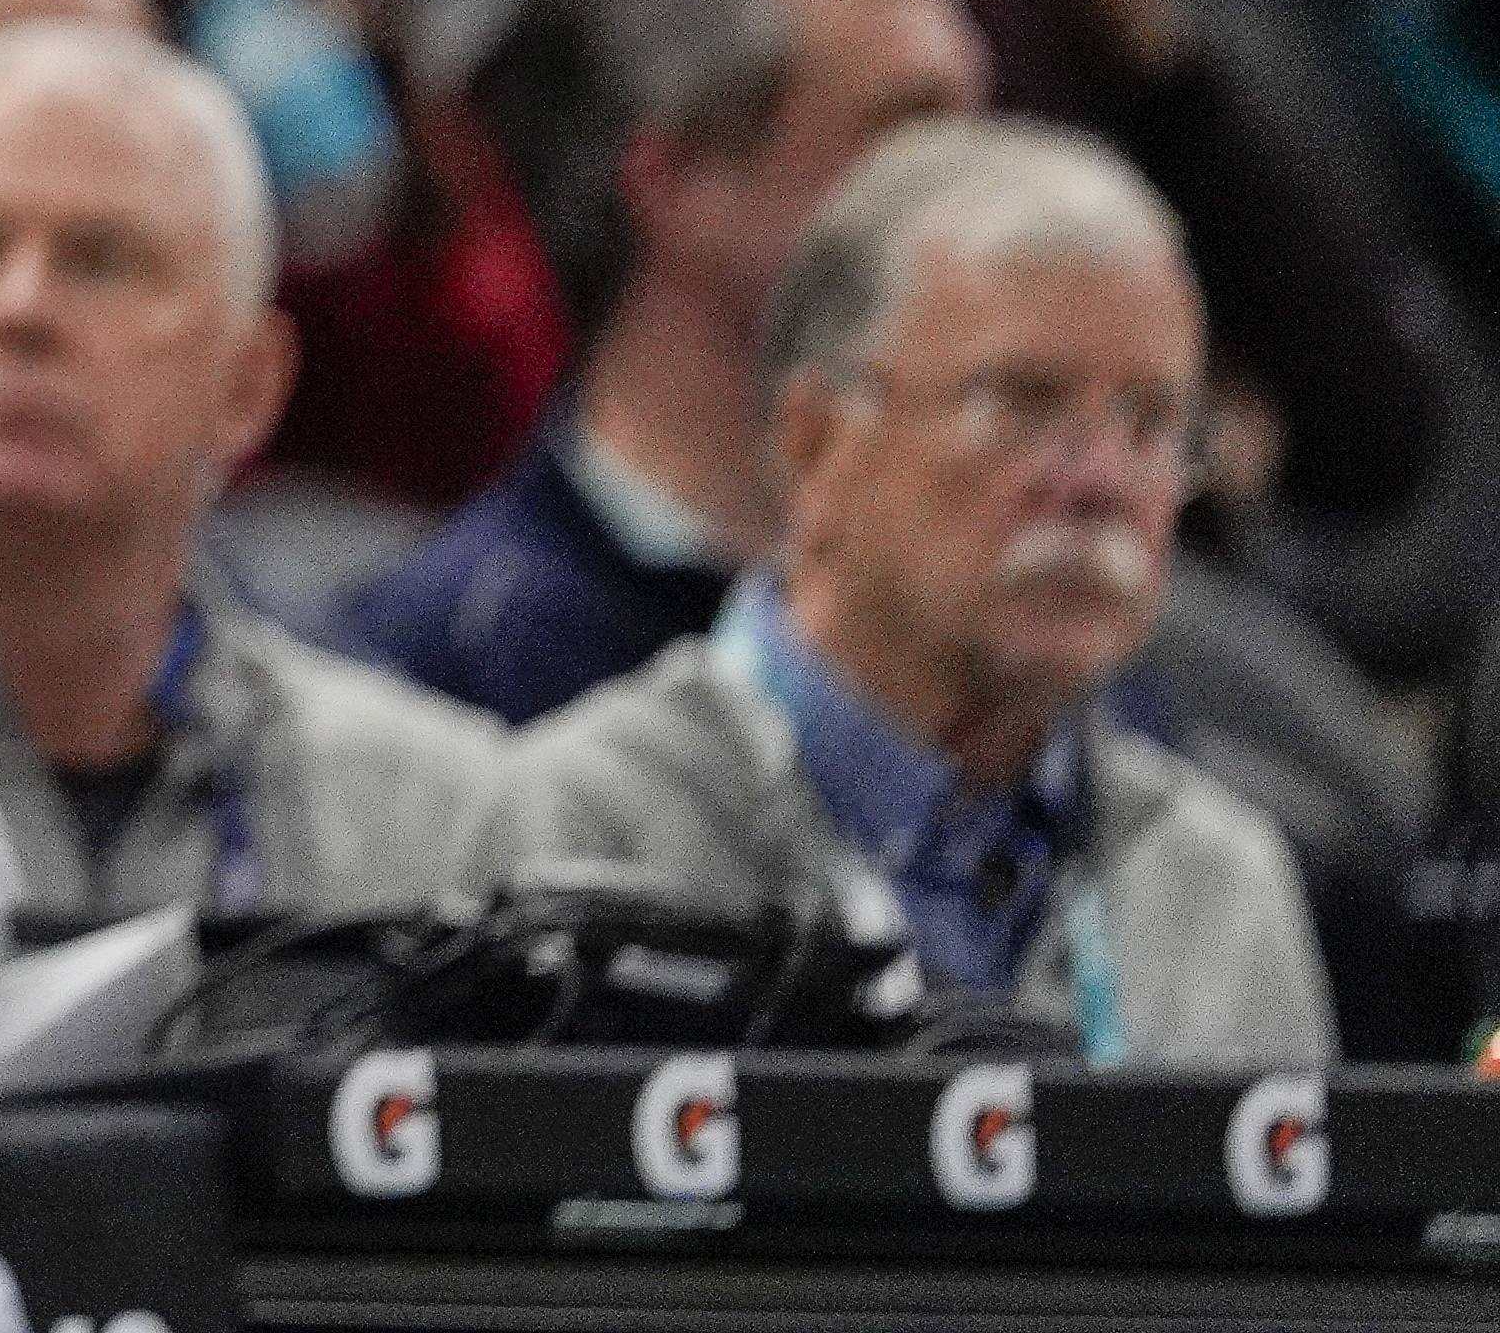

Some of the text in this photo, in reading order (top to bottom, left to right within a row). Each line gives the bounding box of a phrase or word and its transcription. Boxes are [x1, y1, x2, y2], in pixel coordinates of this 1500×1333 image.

[330, 1050, 1330, 1214] G G G G
